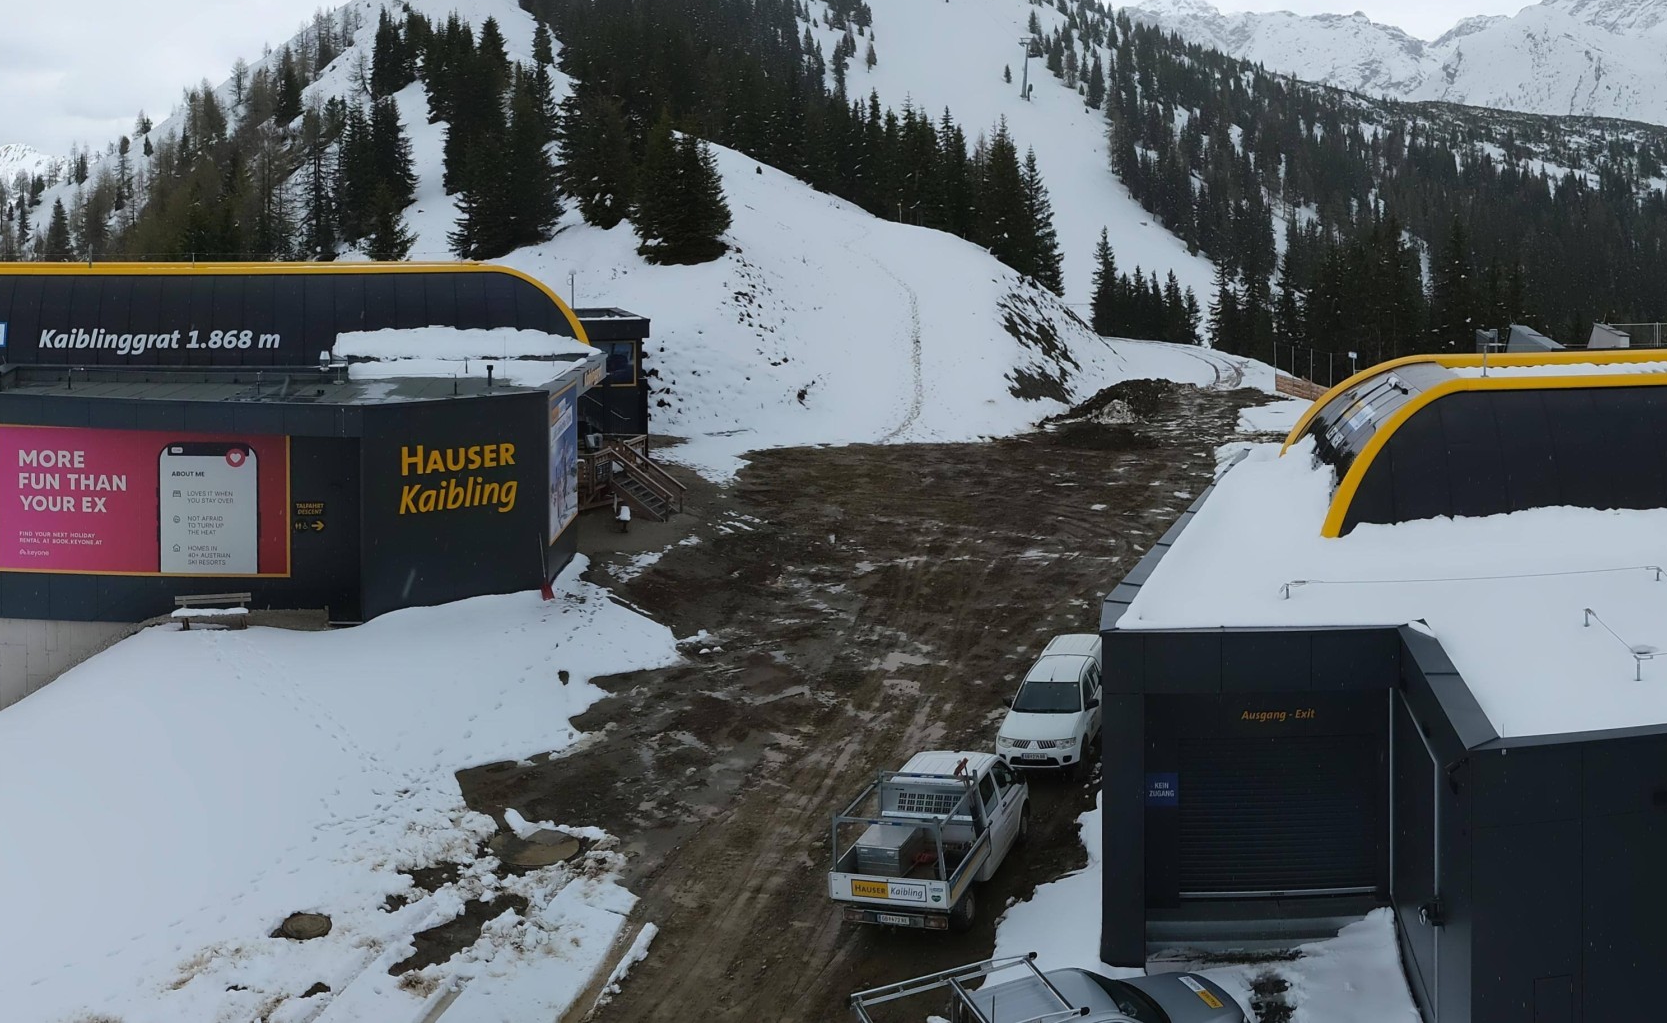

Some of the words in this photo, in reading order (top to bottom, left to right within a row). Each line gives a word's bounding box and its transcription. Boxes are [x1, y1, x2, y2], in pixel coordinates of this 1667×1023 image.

[38, 329, 181, 355] Kaiblinggrat
[186, 330, 253, 349] 1.868
[257, 333, 281, 349] m
[18, 449, 85, 468] MORE
[18, 473, 60, 490] FUN
[67, 474, 127, 491] THAN
[20, 495, 75, 512] YOUR
[82, 497, 107, 513] EX
[399, 477, 518, 515] Kaibling
[27, 549, 49, 557] keyone
[1241, 710, 1286, 722] Ausgang
[1295, 708, 1315, 719] Exit
[890, 886, 923, 899] Kaibling
